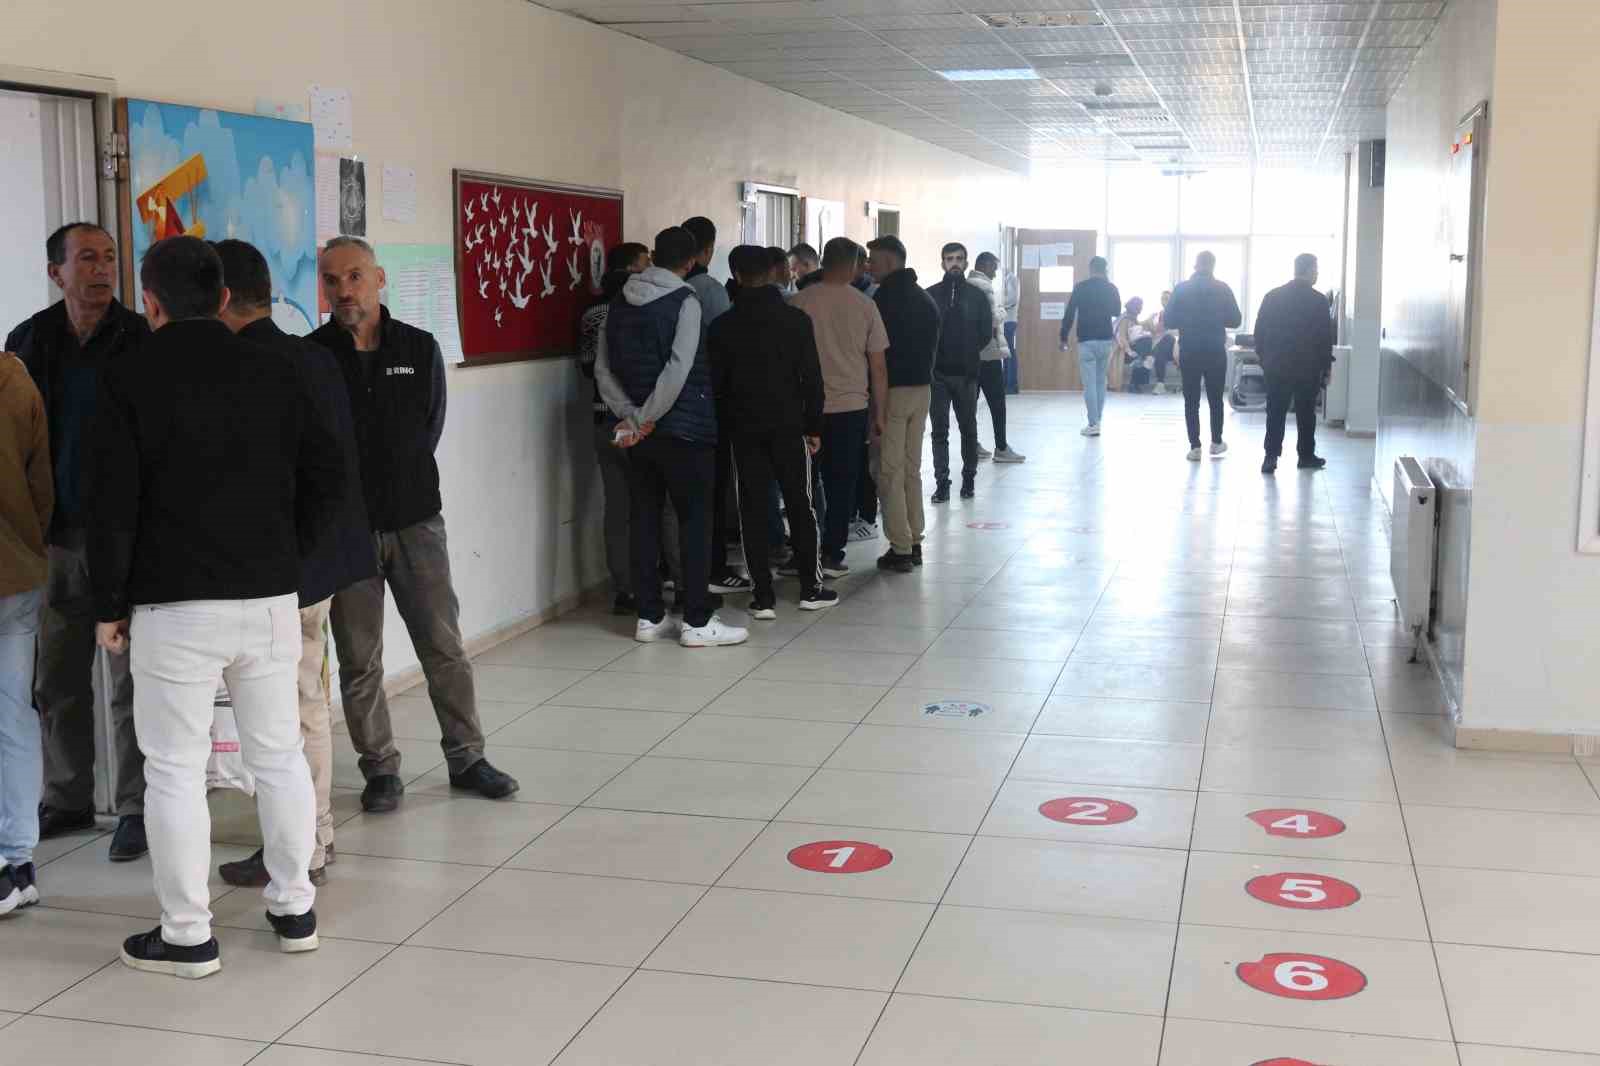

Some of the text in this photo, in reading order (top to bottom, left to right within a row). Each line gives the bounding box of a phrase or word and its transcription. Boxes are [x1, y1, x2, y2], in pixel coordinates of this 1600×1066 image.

[1064, 801, 1110, 821] 2
[1270, 814, 1317, 834] 4
[823, 846, 855, 868] 1
[1279, 878, 1327, 903] 5
[1273, 960, 1329, 992] 6
